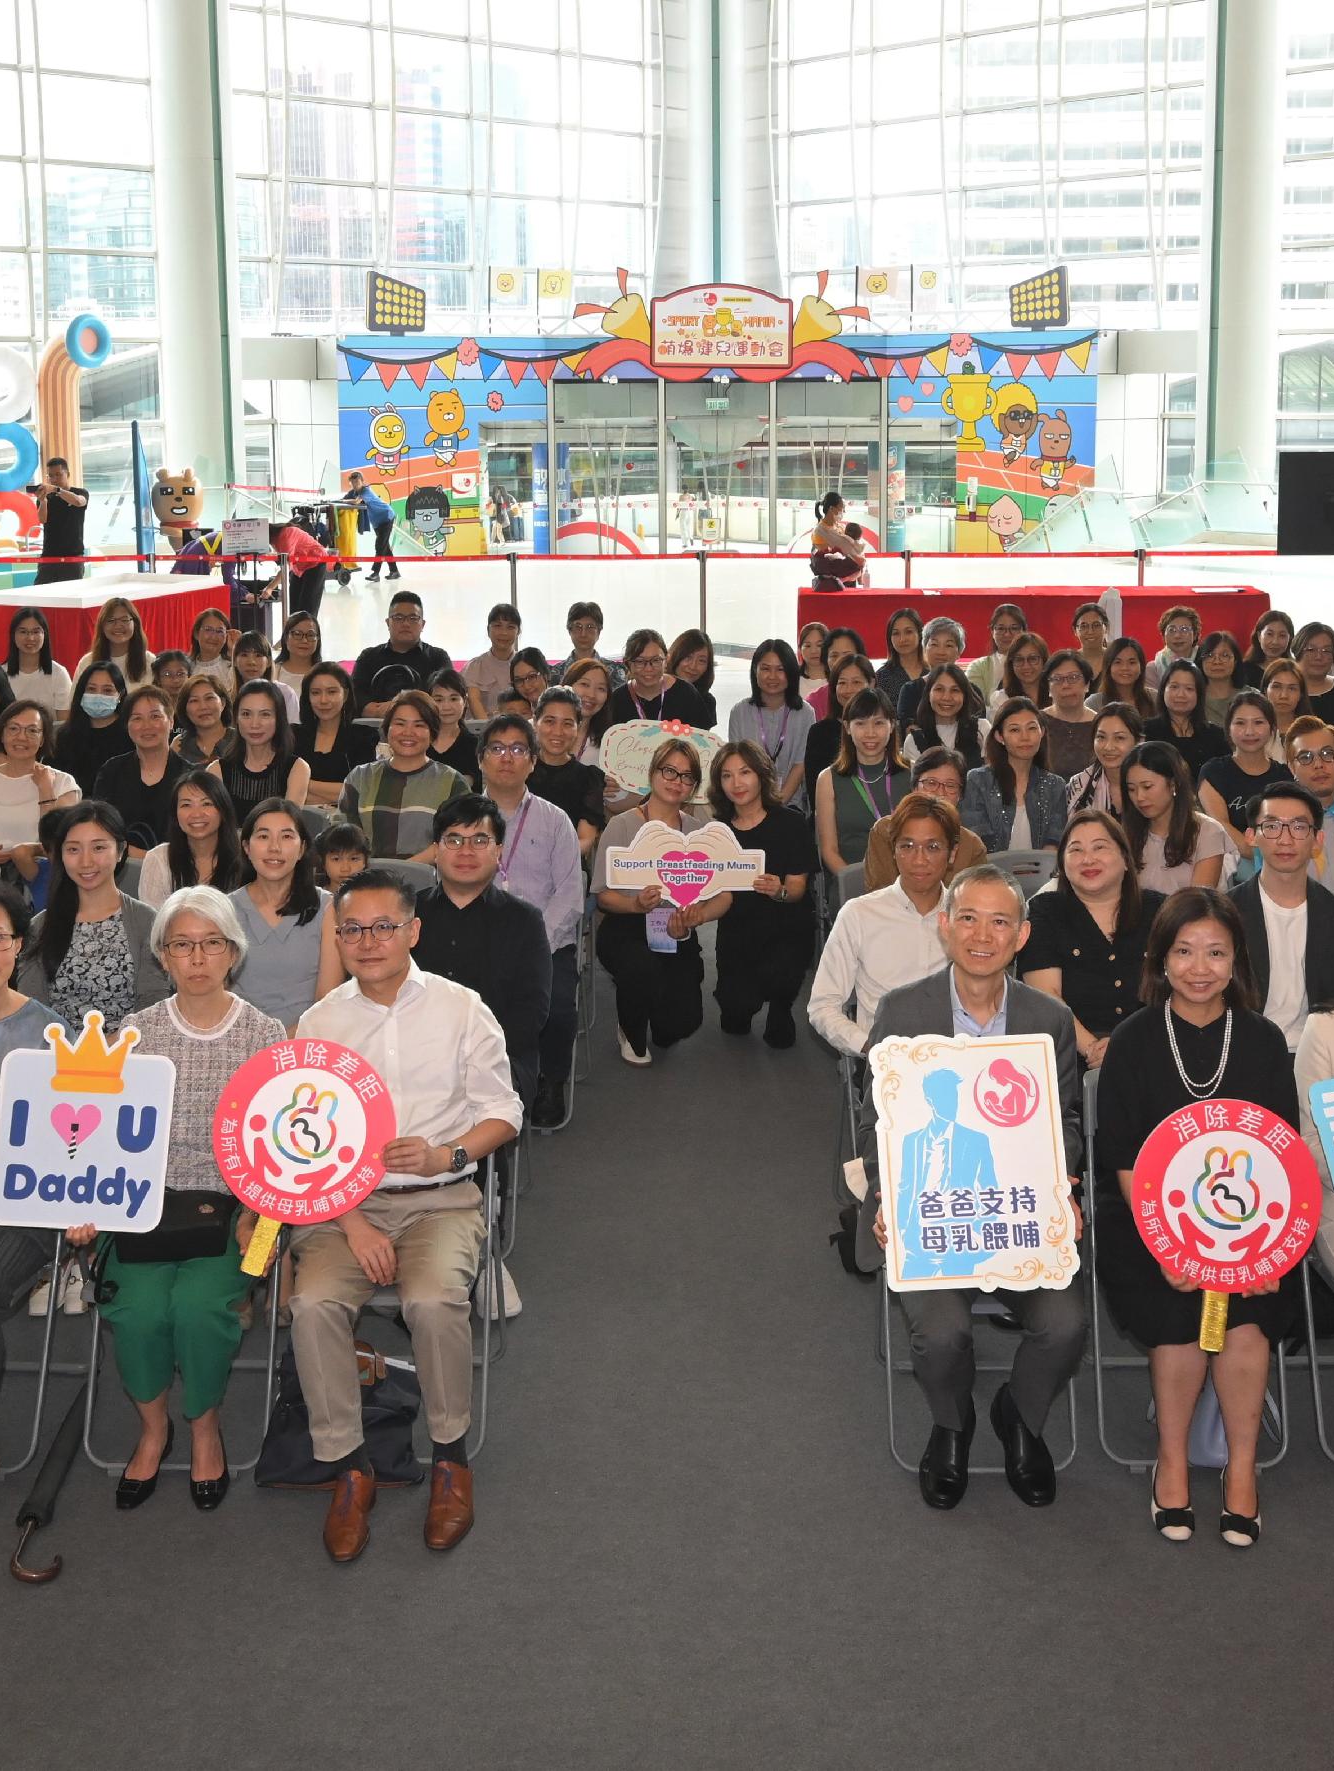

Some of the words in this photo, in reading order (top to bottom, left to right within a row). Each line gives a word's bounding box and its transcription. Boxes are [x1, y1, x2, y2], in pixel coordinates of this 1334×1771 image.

[613, 858, 653, 870] Support
[656, 859, 724, 872] Breastfeeding
[727, 861, 756, 870] Mums
[662, 872, 707, 883] Together
[271, 1042, 384, 1104] 消除差距
[9, 1100, 30, 1147] I
[116, 1105, 157, 1153] U
[1170, 1104, 1296, 1155] 消除差距
[3, 1163, 151, 1219] Daddy
[220, 1118, 377, 1217] 為所有人提供母乳哺育支持
[919, 1186, 1037, 1219] 爸爸支持
[921, 1221, 1040, 1253] 母乳餵哺
[1141, 1199, 1311, 1285] 為所有人提供母乳哺育支持
